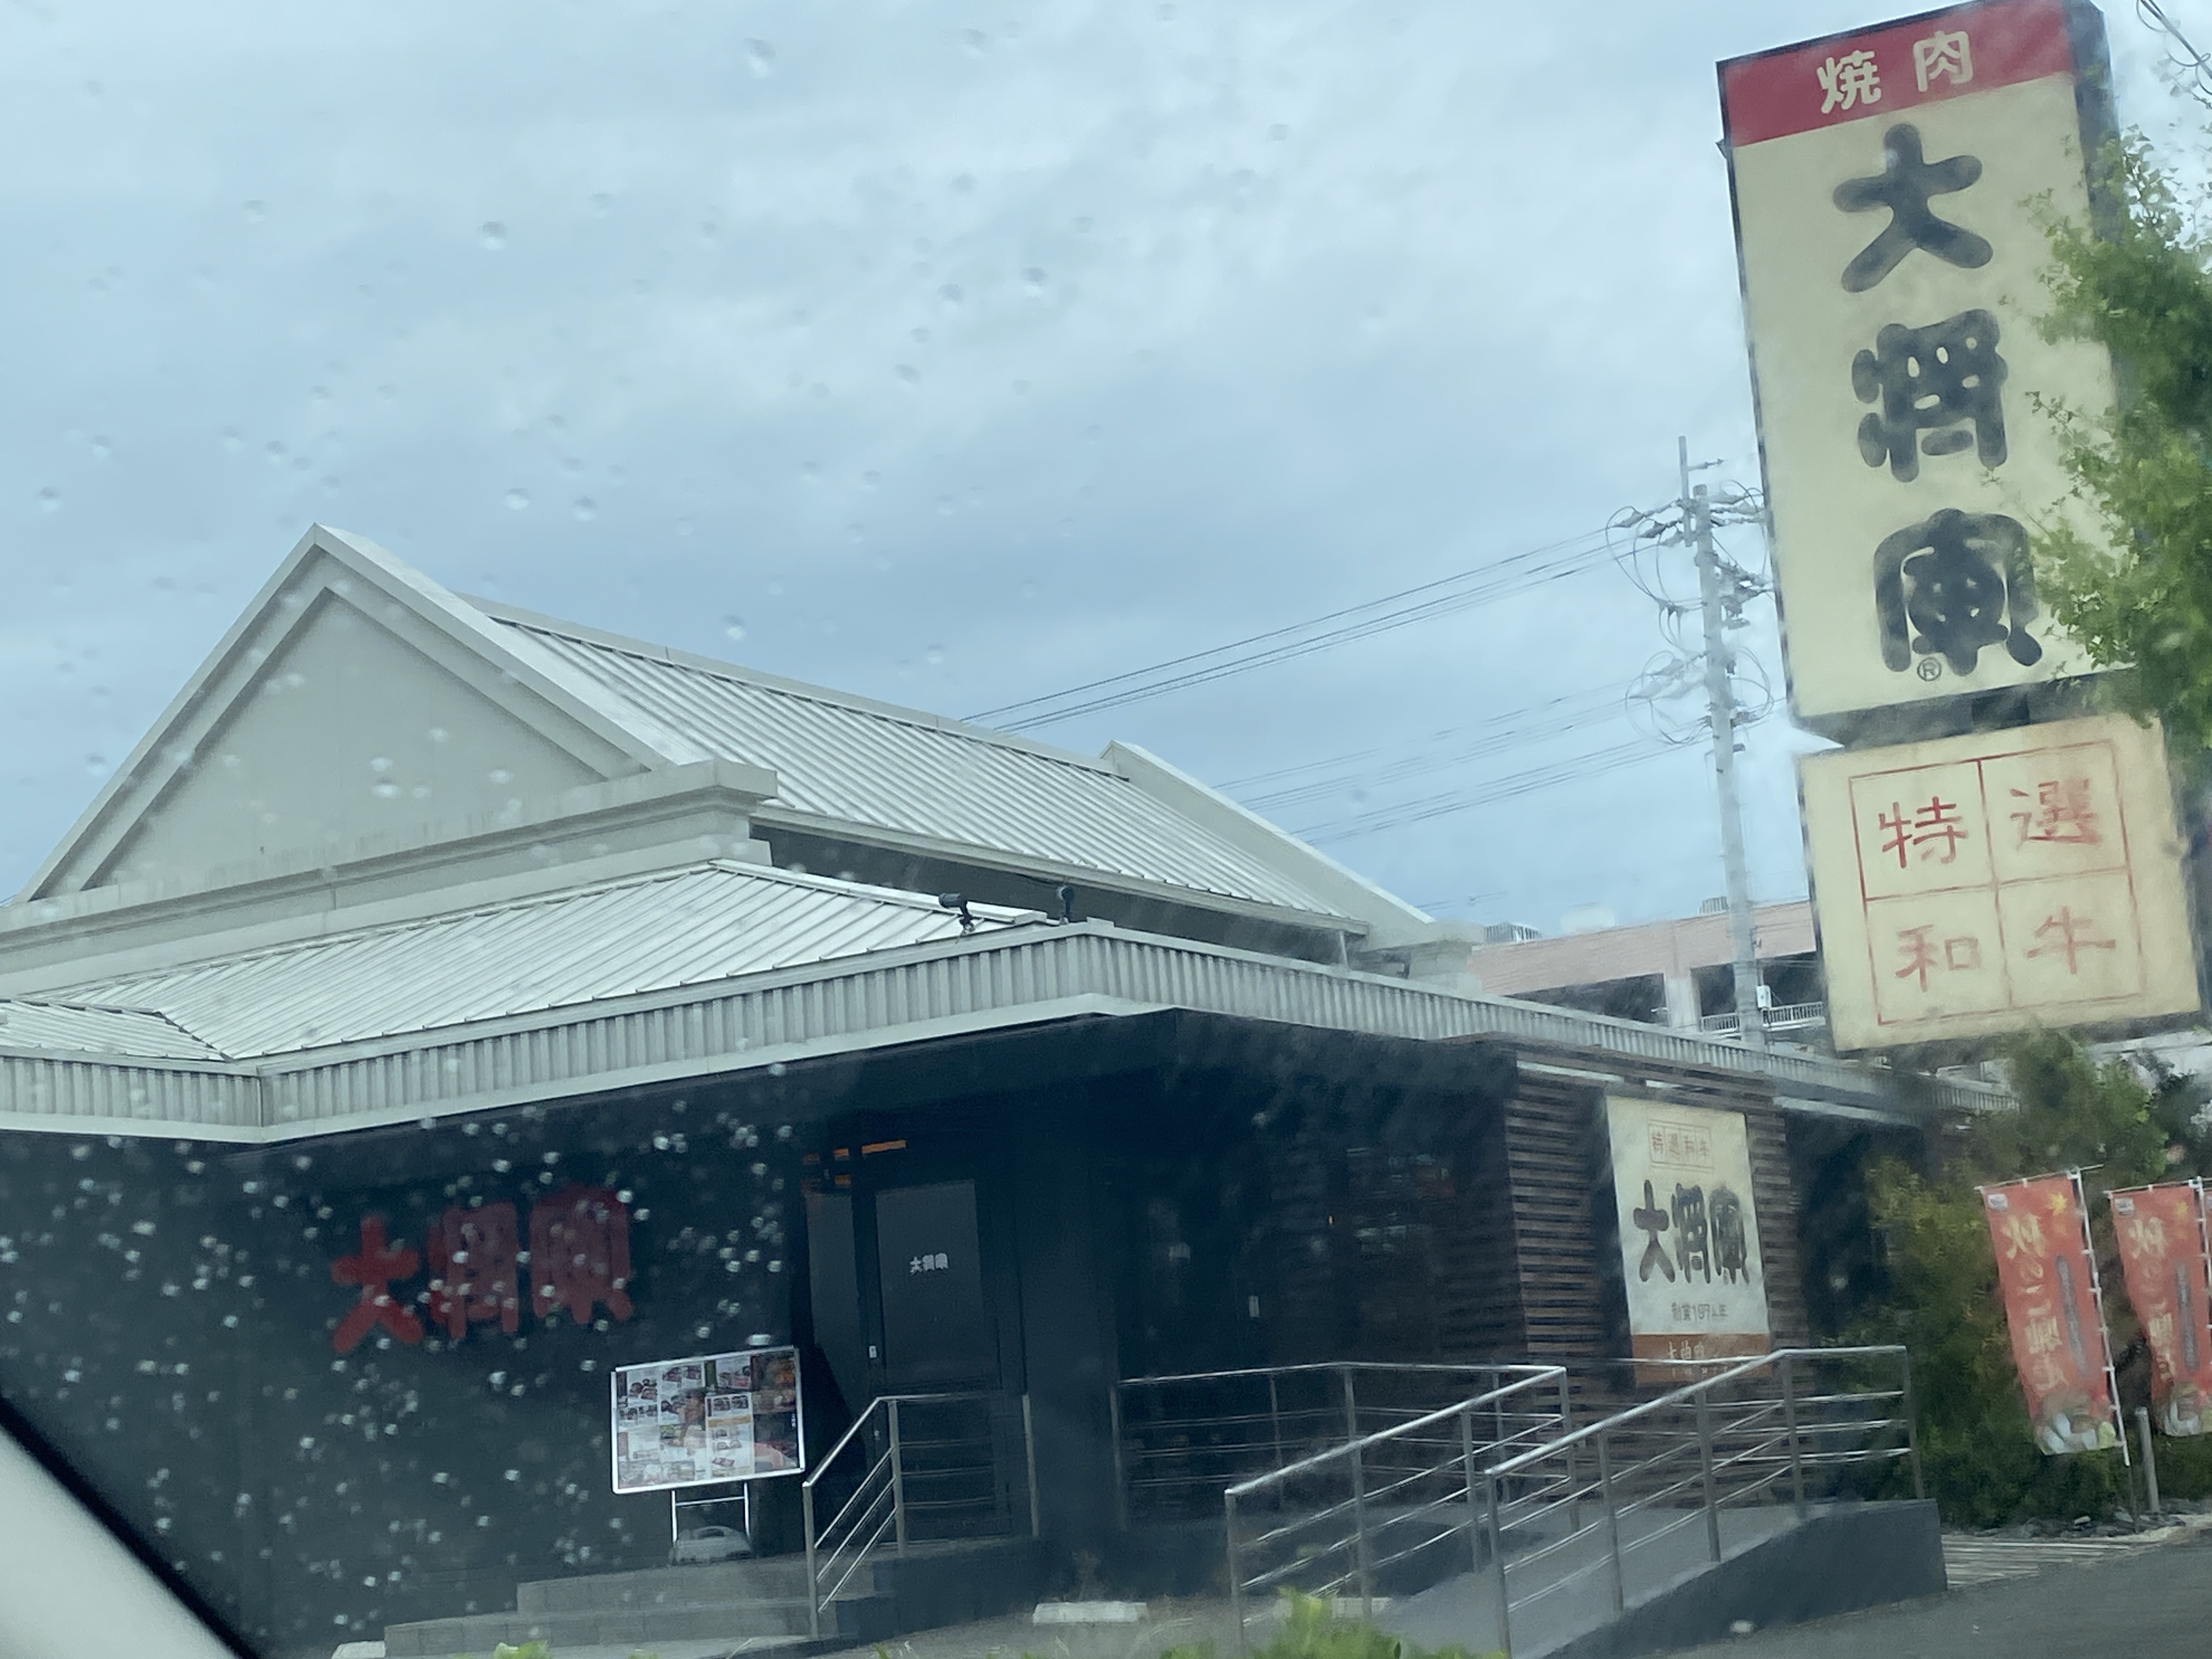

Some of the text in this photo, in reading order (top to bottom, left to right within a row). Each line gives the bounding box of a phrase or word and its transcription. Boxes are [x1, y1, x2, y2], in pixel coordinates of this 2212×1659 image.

[1816, 30, 1974, 114] 焼肉
[1878, 777, 2103, 870] 特選
[1895, 905, 2117, 993] 和牛
